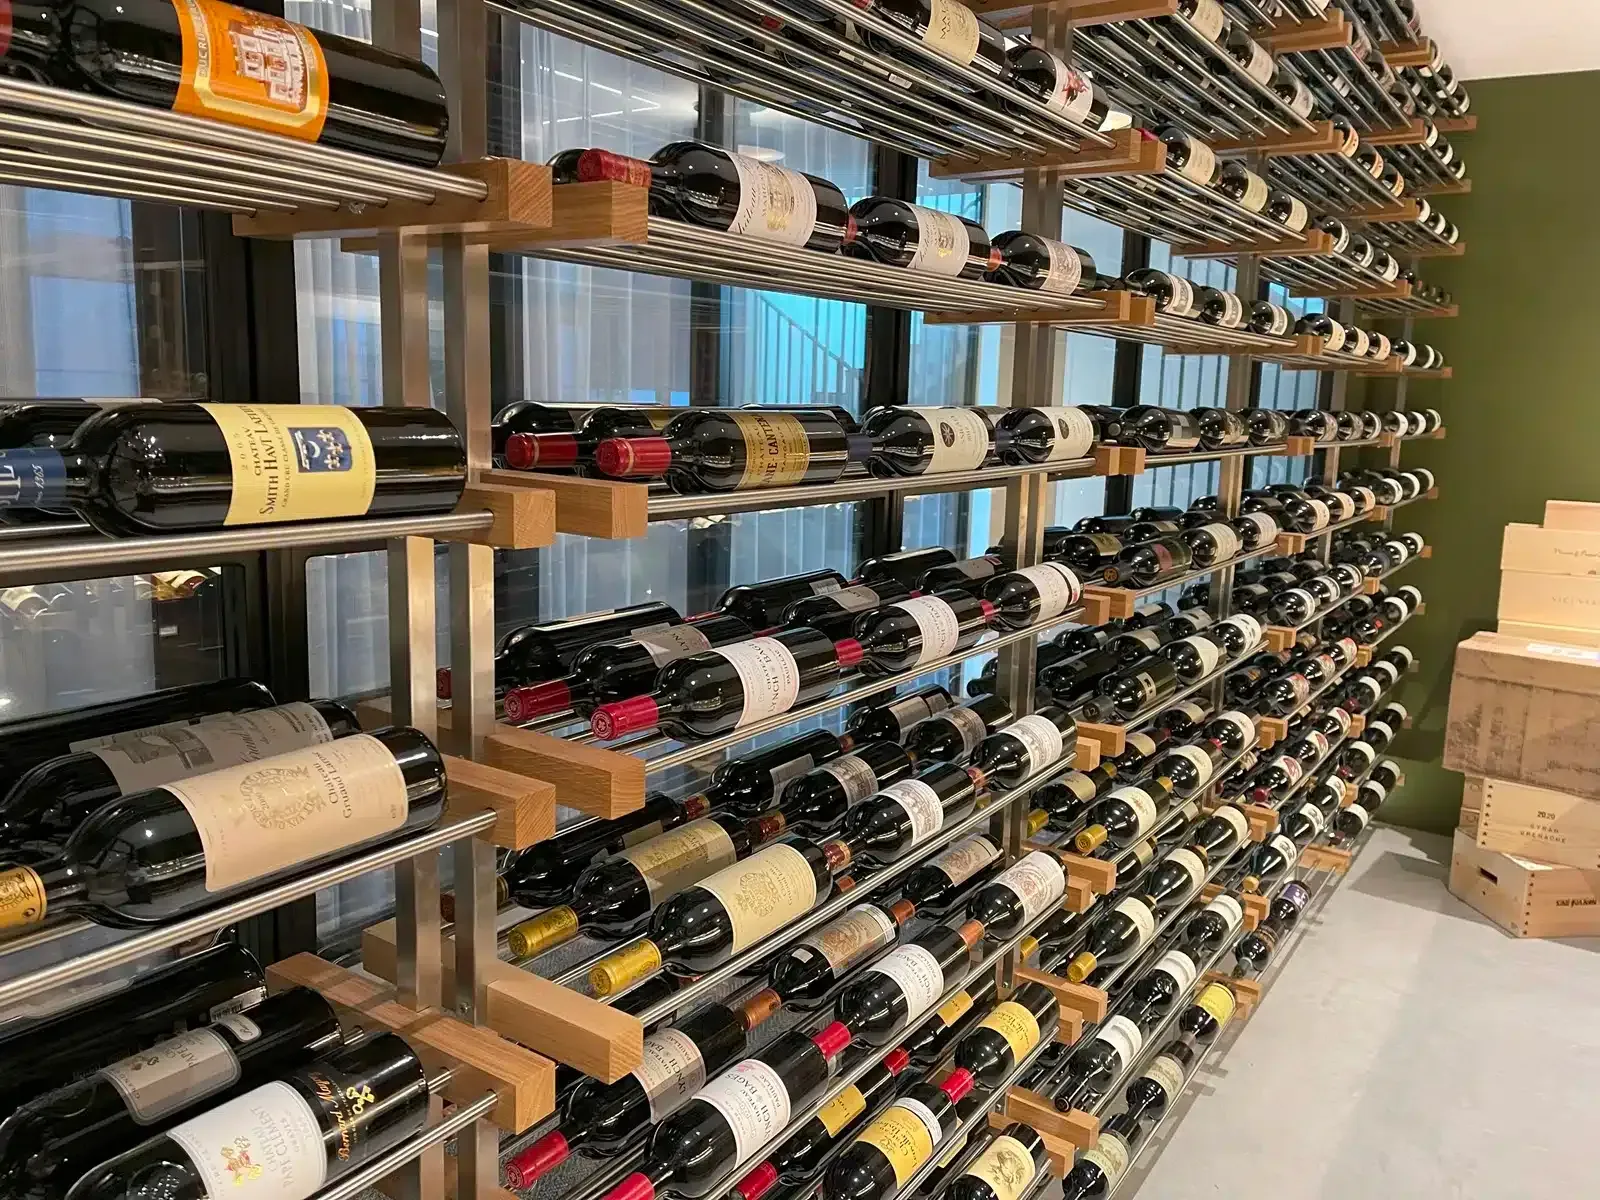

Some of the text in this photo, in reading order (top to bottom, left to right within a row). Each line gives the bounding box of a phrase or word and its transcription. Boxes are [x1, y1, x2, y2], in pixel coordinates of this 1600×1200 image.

[32, 463, 45, 489] 1365
[259, 475, 279, 515] SMITH
[281, 483, 291, 508] GRAND
[767, 675, 781, 713] LYNCH
[313, 762, 339, 804] Château
[335, 776, 352, 819] Gruaud
[1537, 811, 1556, 821] 2020
[646, 1040, 665, 1052] BAG
[666, 1035, 692, 1062] PAUILLAC
[668, 1058, 688, 1095] LYNCH
[725, 1073, 758, 1095] BAGES
[759, 1074, 781, 1108] PAUILLAC
[329, 1110, 351, 1162] Bernard
